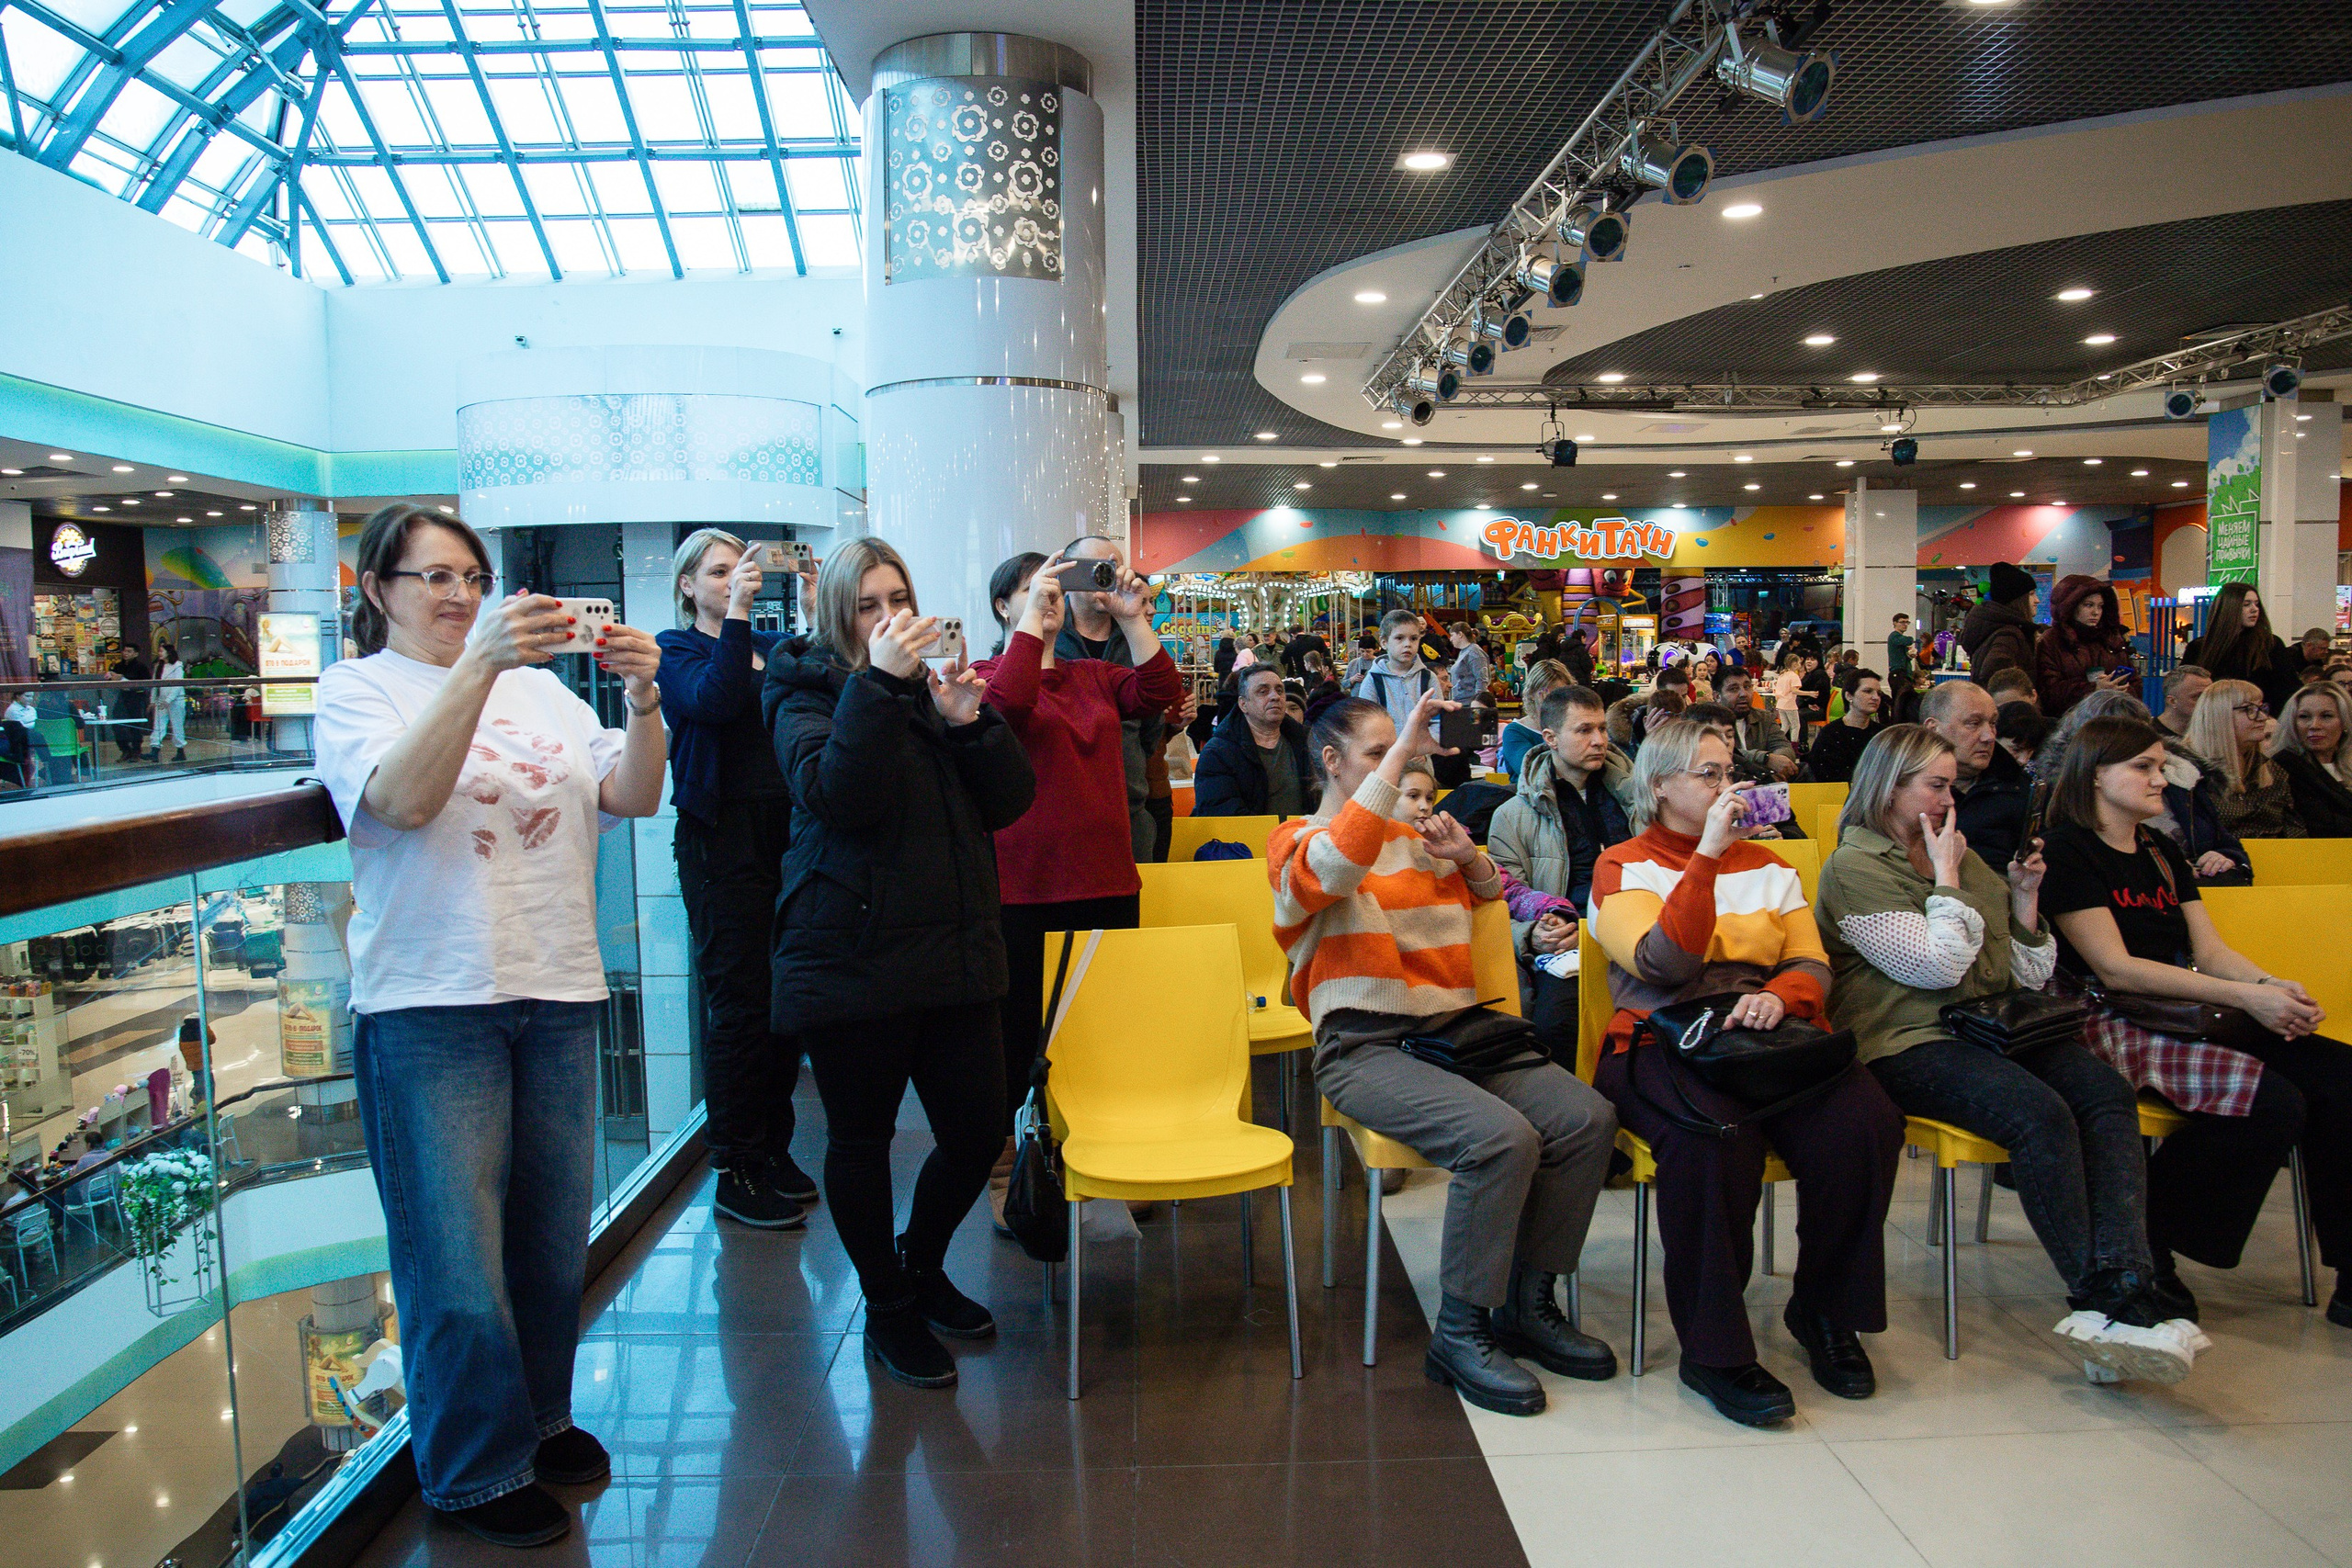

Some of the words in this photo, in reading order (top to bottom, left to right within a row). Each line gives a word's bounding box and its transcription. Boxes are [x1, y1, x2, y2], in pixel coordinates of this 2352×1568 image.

[2218, 519, 2251, 536] МЕНЯЕМ
[1482, 518, 1675, 558] ФАНКИТАУН
[2217, 534, 2250, 549] ЧАЙНЫЕ
